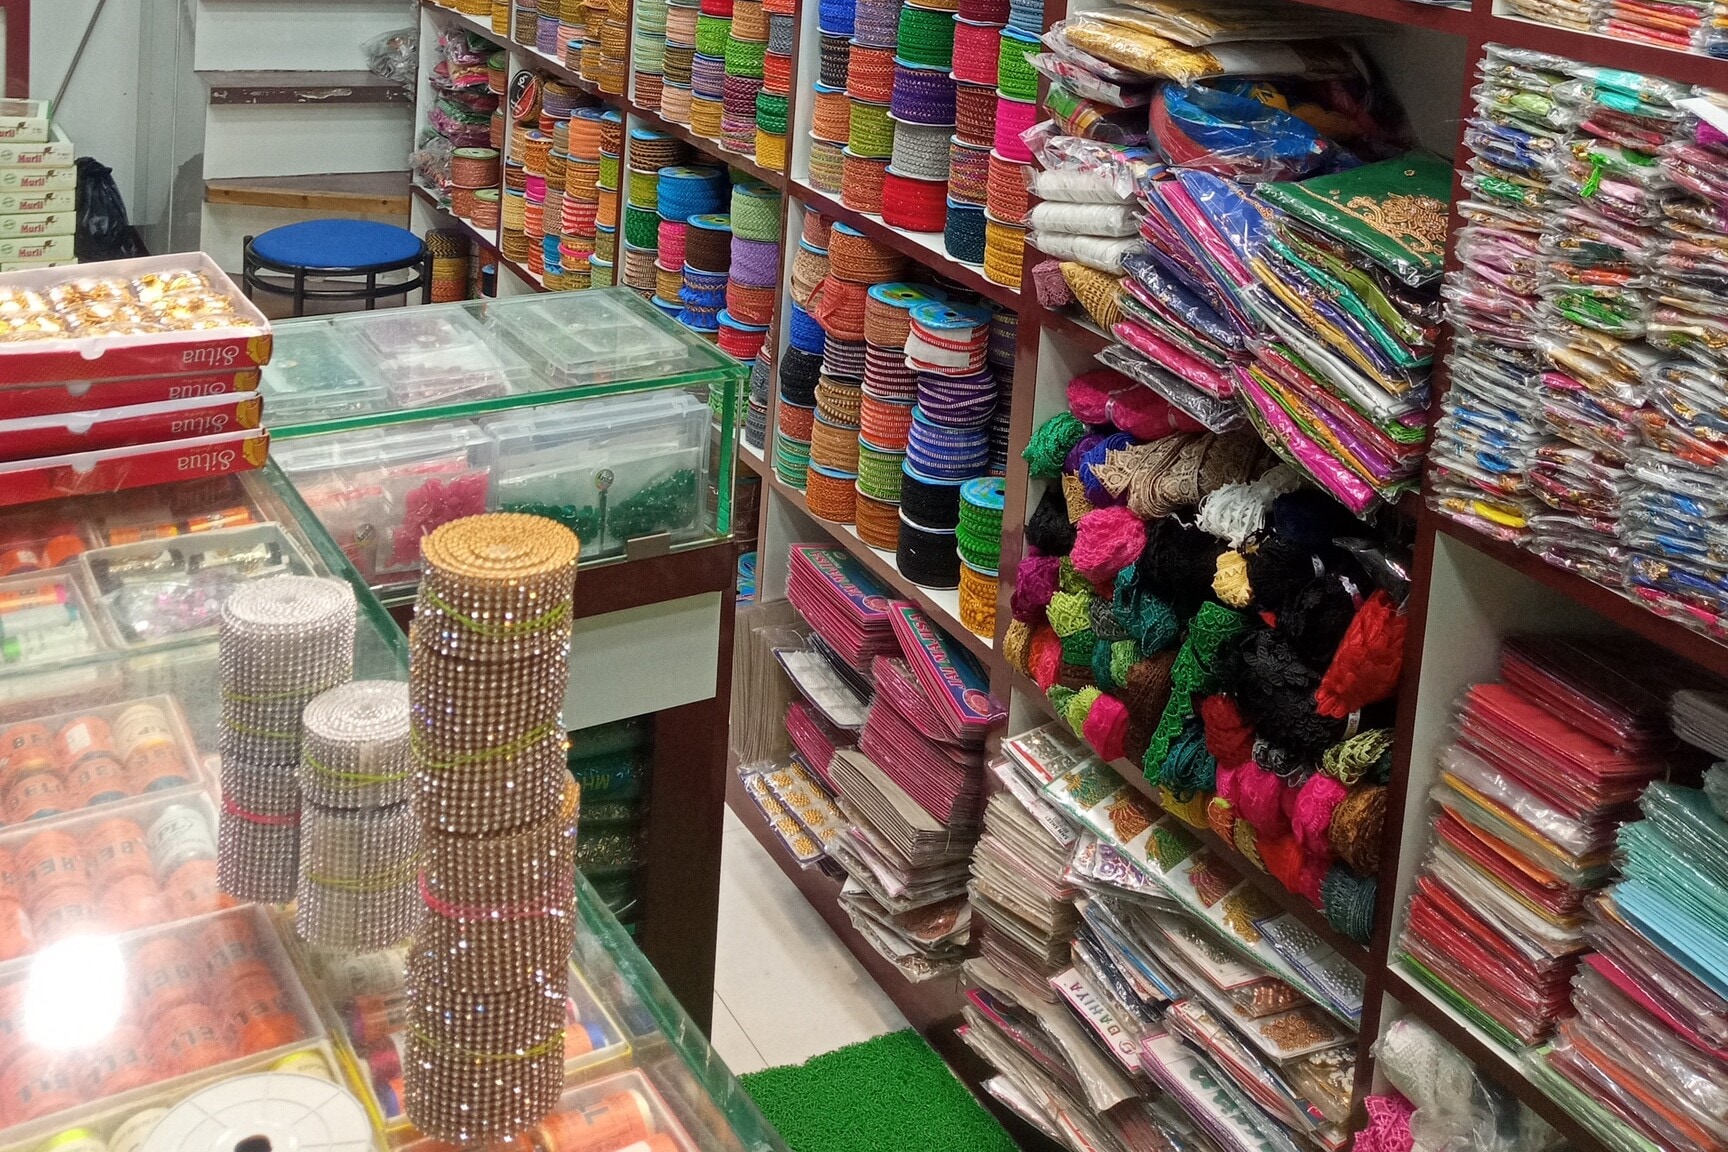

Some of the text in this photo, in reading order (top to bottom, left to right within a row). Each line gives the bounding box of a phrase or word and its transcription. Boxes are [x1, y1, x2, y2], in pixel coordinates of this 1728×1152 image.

[182, 345, 240, 366] Situa
[171, 413, 229, 434] Situa
[177, 449, 236, 471] Situa
[1070, 981, 1121, 1036] DAHIYA
